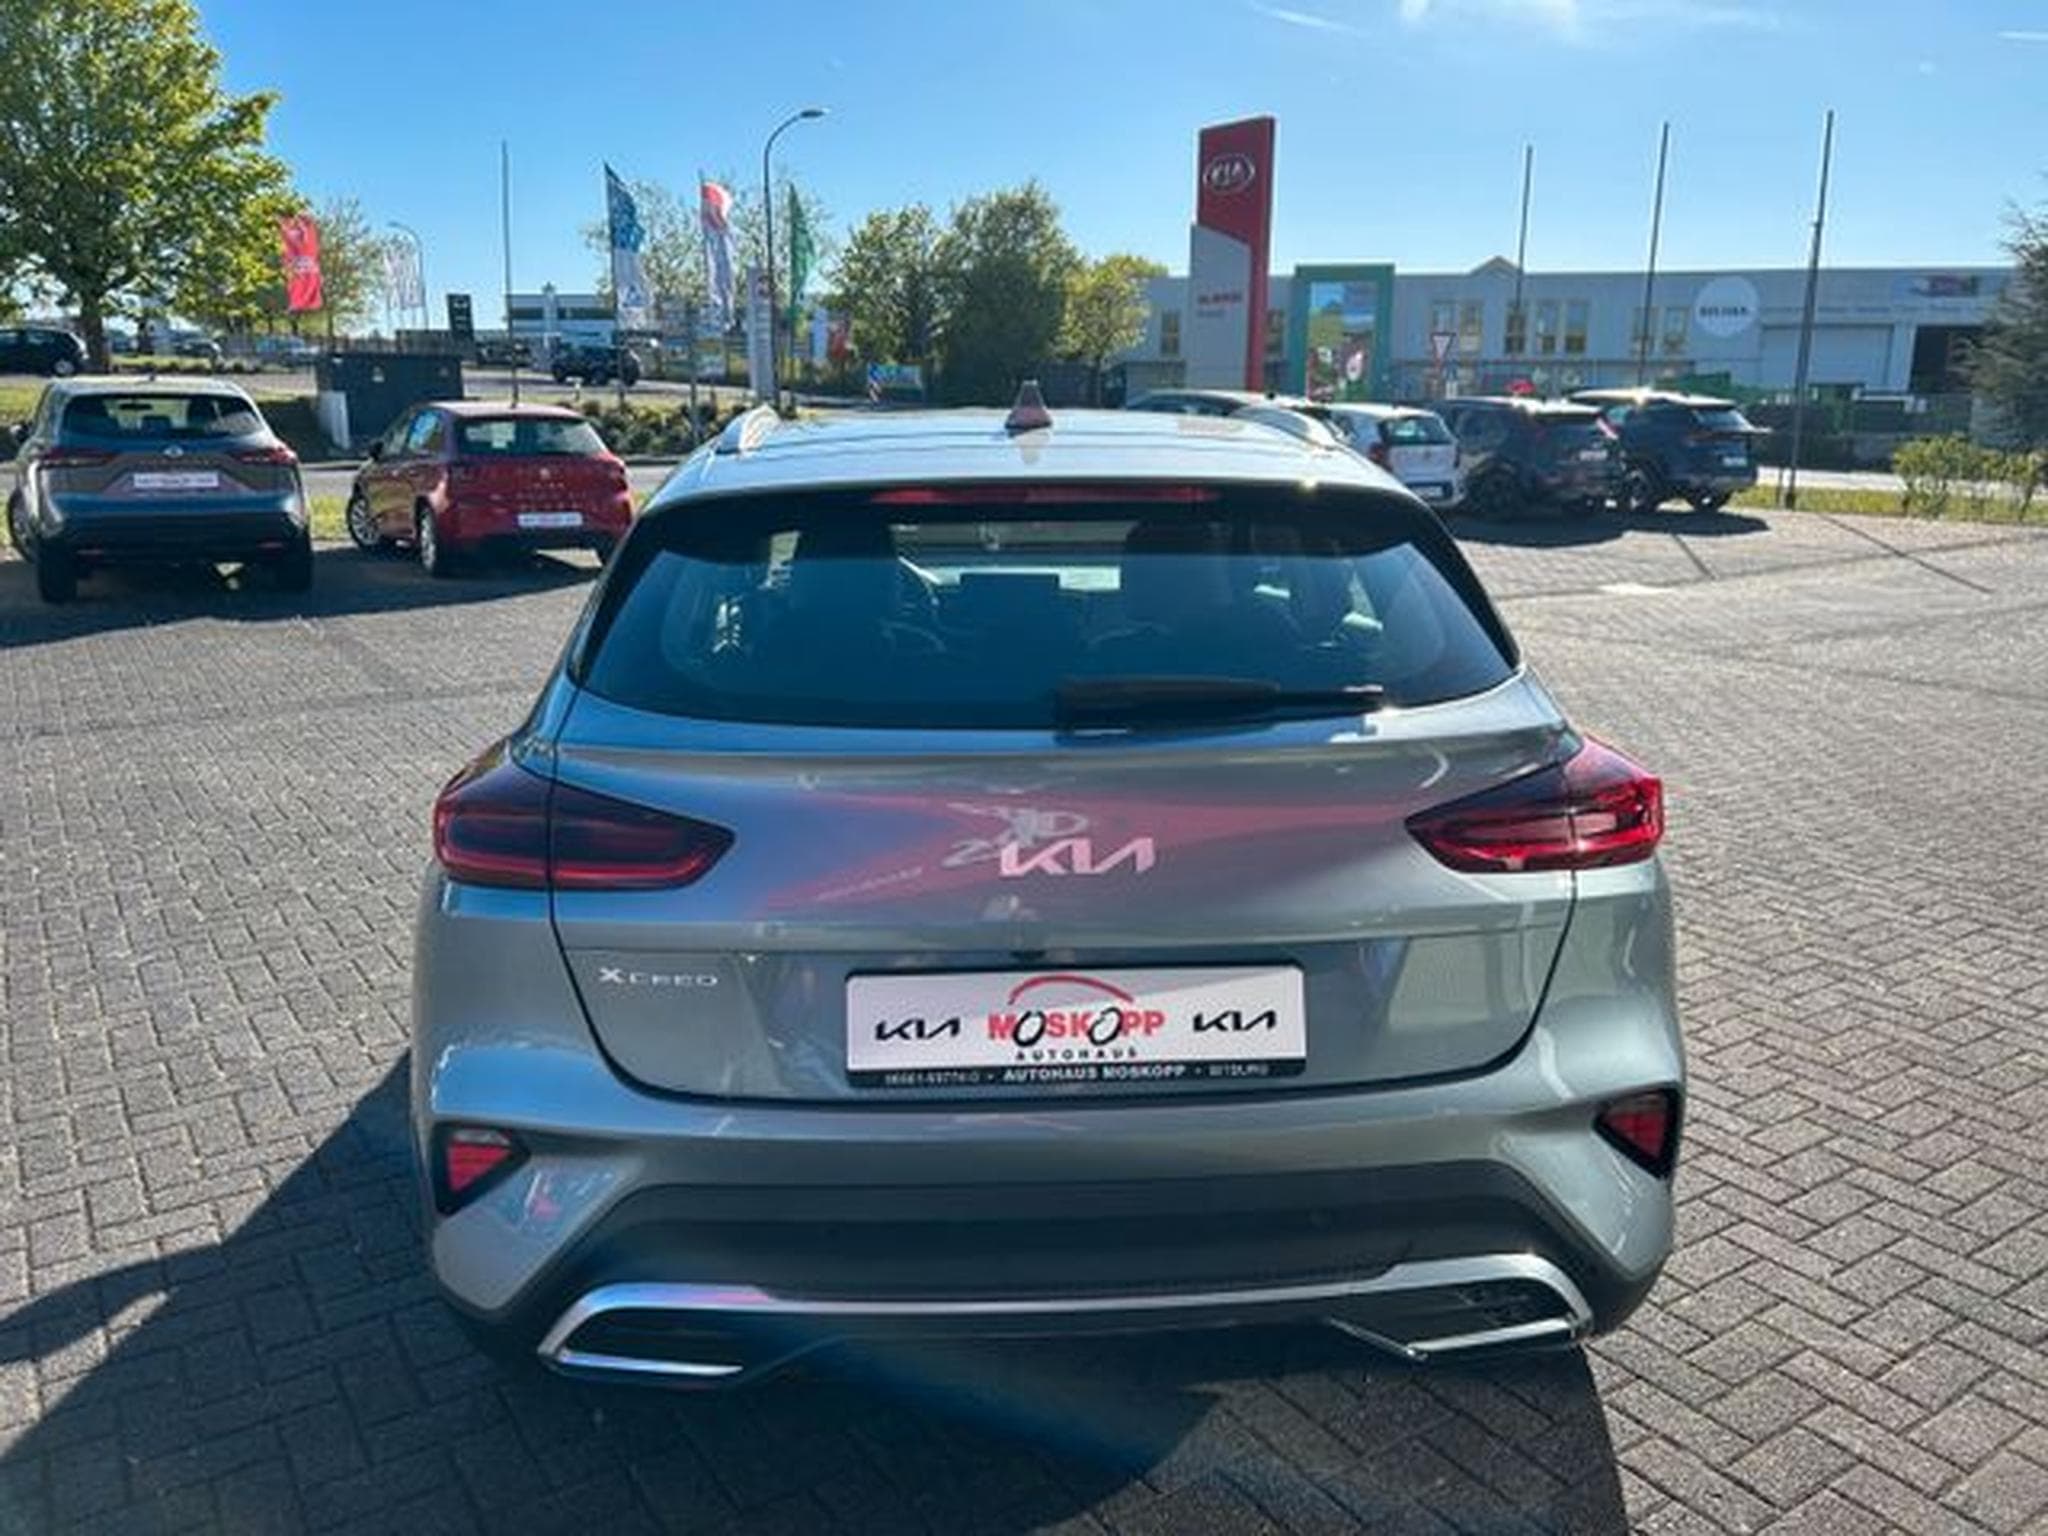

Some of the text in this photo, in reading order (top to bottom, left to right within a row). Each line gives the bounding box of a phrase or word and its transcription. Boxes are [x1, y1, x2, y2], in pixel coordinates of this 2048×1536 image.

[1000, 837, 1154, 877] KIA
[874, 1016, 961, 1041] KIA
[987, 1007, 1166, 1048] MOSKOPP
[1193, 1009, 1277, 1033] KIA
[1015, 1047, 1138, 1061] AUTOHAUS
[1003, 1065, 1098, 1082] AUTOHAUS
[1102, 1063, 1186, 1079] MOSKOPP
